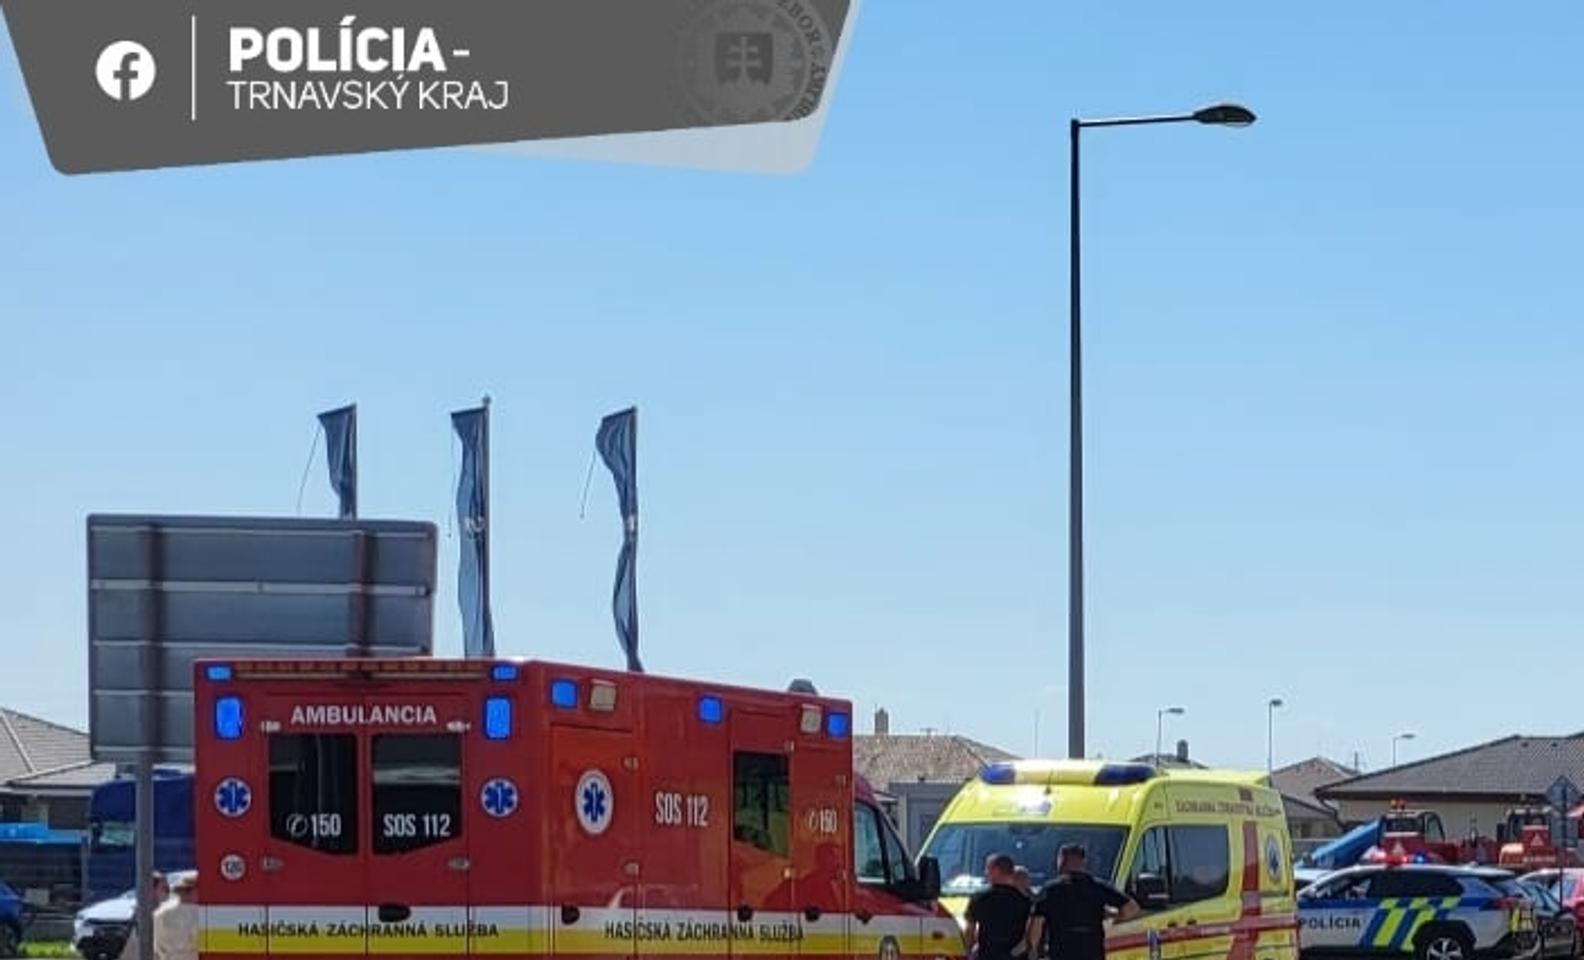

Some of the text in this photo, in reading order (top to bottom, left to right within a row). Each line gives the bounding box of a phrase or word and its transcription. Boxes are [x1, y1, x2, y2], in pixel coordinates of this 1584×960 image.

[291, 705, 437, 724] AMBULANCIA
[655, 792, 709, 827] SOS 112
[311, 813, 342, 836] 150
[383, 813, 451, 837] SOS 112
[238, 919, 499, 937] HASIČSKÁ ZÁCHRANNÁ SLUŽBA
[605, 917, 804, 942] HASIČSKÁ ZÁCHRANNÁ SLUŽBA
[1300, 915, 1361, 931] POLÍCIA
